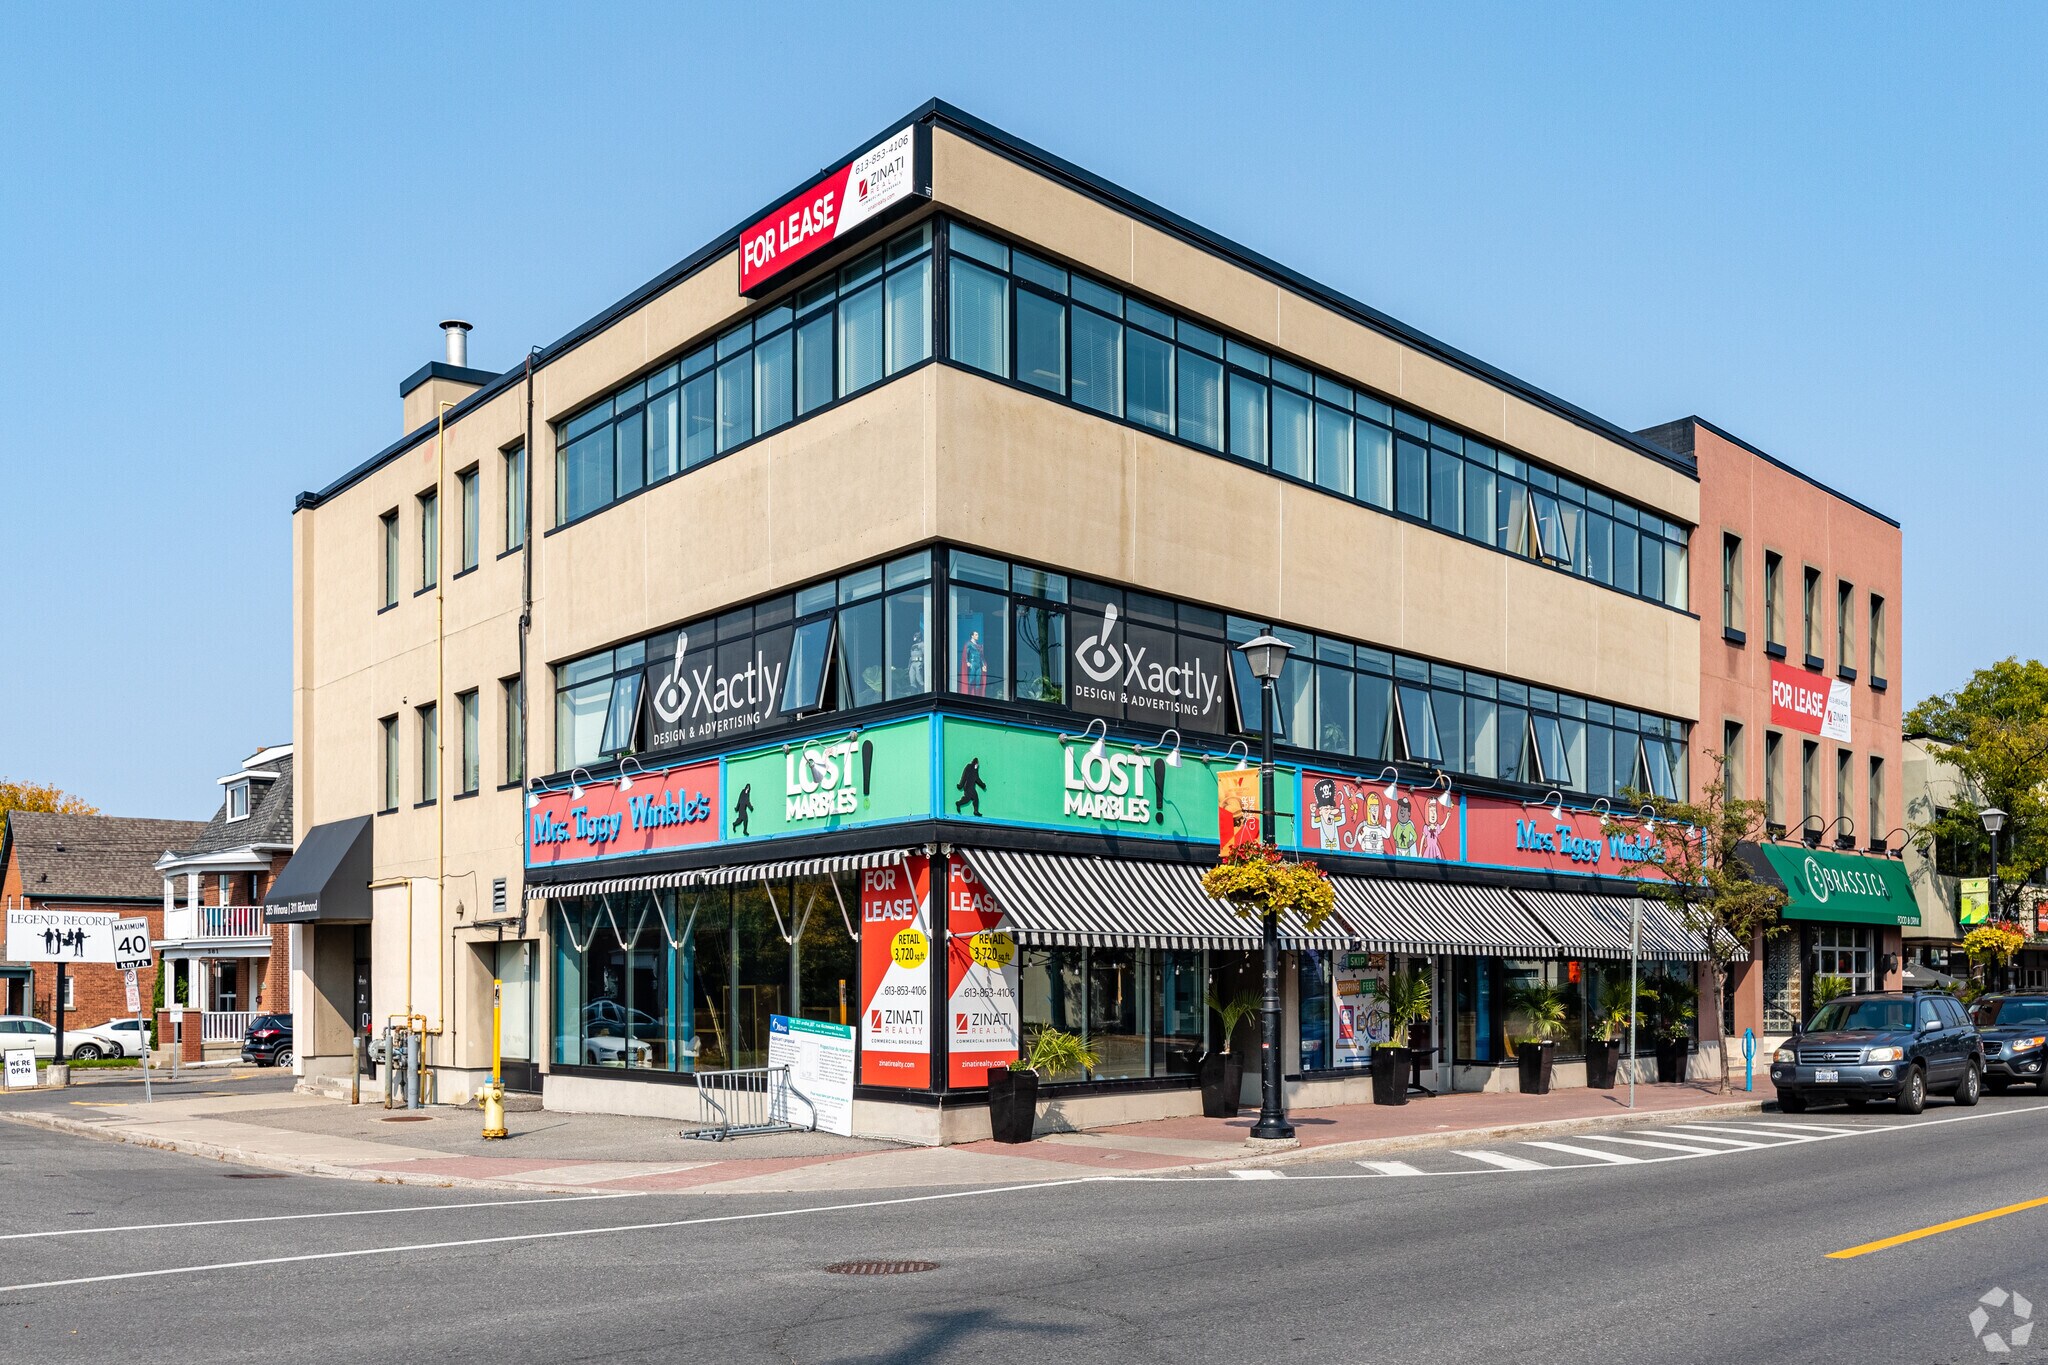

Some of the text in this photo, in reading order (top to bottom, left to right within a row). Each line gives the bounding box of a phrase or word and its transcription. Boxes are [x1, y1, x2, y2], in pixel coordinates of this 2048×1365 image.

[855, 134, 909, 174] 613-853-4106
[870, 156, 904, 186] ZINATI
[744, 191, 834, 275] FOR LEASE
[1075, 685, 1198, 716] DESIGN & ADVERTISING
[1772, 680, 1823, 718] FOR LEASE
[653, 711, 760, 745] DESIGN & ADVERTISING
[786, 742, 858, 795] LOST
[1064, 746, 1151, 797] LOST
[786, 787, 858, 821] MARBLES
[1064, 790, 1150, 823] MARBLES
[533, 788, 711, 845] Mrs. Tiggy Winkle's
[1516, 819, 1556, 853] Mrs.
[1556, 824, 1602, 863] Tiggy
[865, 869, 896, 892] FOR
[951, 863, 979, 884] FO
[1823, 868, 1889, 897] BRASSICA
[297, 900, 317, 912] Richmond
[865, 899, 912, 922] LEASE
[10, 914, 59, 926] LEGEND
[114, 922, 145, 931] MAXIMUM
[118, 935, 146, 954] 40
[898, 934, 920, 945] RETAIL
[979, 933, 1005, 945] RETAIL
[895, 947, 914, 962] 3,720
[974, 947, 998, 962] 3,720
[1350, 956, 1365, 966] SKIP
[120, 959, 148, 968] km/h
[884, 985, 927, 996] 613-853-4106
[964, 987, 1015, 998] 613-853-4106
[1338, 981, 1375, 992] SHIPPING FEES
[885, 1010, 923, 1025] ZINATI
[972, 1013, 1011, 1026] ZINATI
[885, 1026, 923, 1034] REALTY
[971, 1027, 1011, 1035] REALTY
[11, 1067, 31, 1075] OPEN
[879, 1060, 915, 1069] zinatirealty.com
[962, 1060, 1006, 1068] zinatirealty.com
